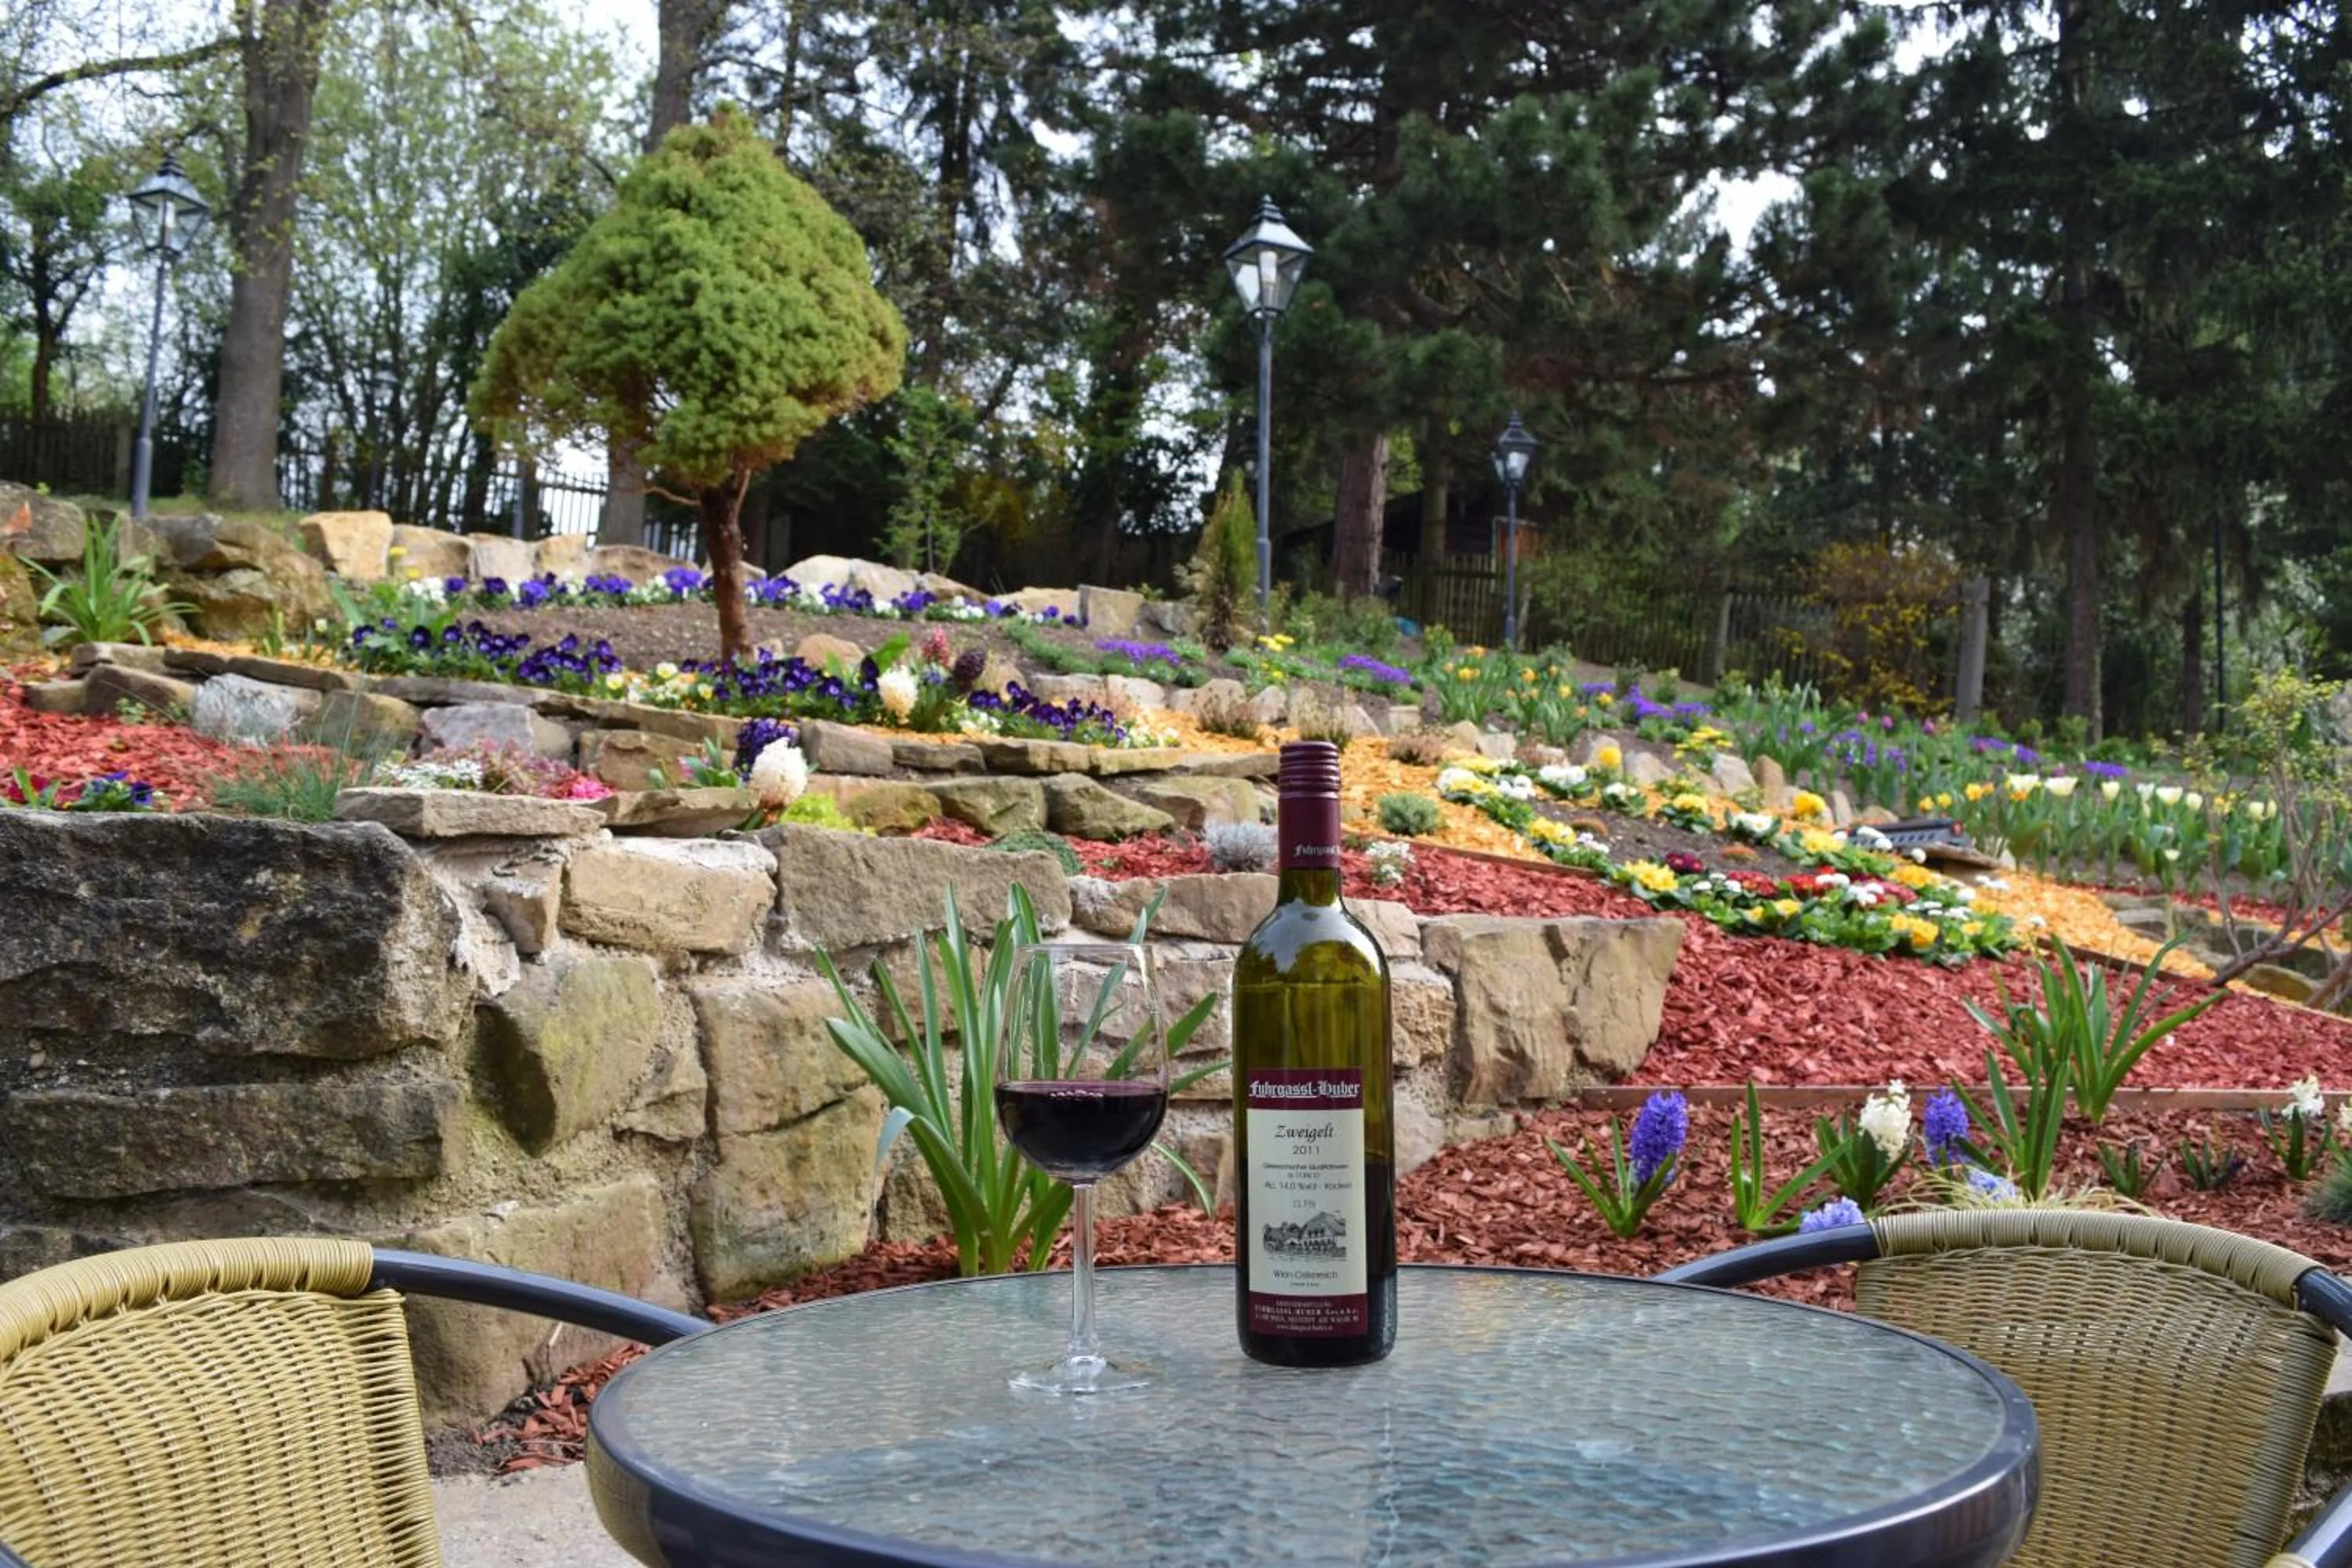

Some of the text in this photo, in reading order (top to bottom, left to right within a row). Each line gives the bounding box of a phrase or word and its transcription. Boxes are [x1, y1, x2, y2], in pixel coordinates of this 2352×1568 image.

[1248, 1080, 1361, 1098] Fuhrgassl-Huber
[1275, 1122, 1334, 1142] Zweigelt
[1293, 1145, 1320, 1156] 2011
